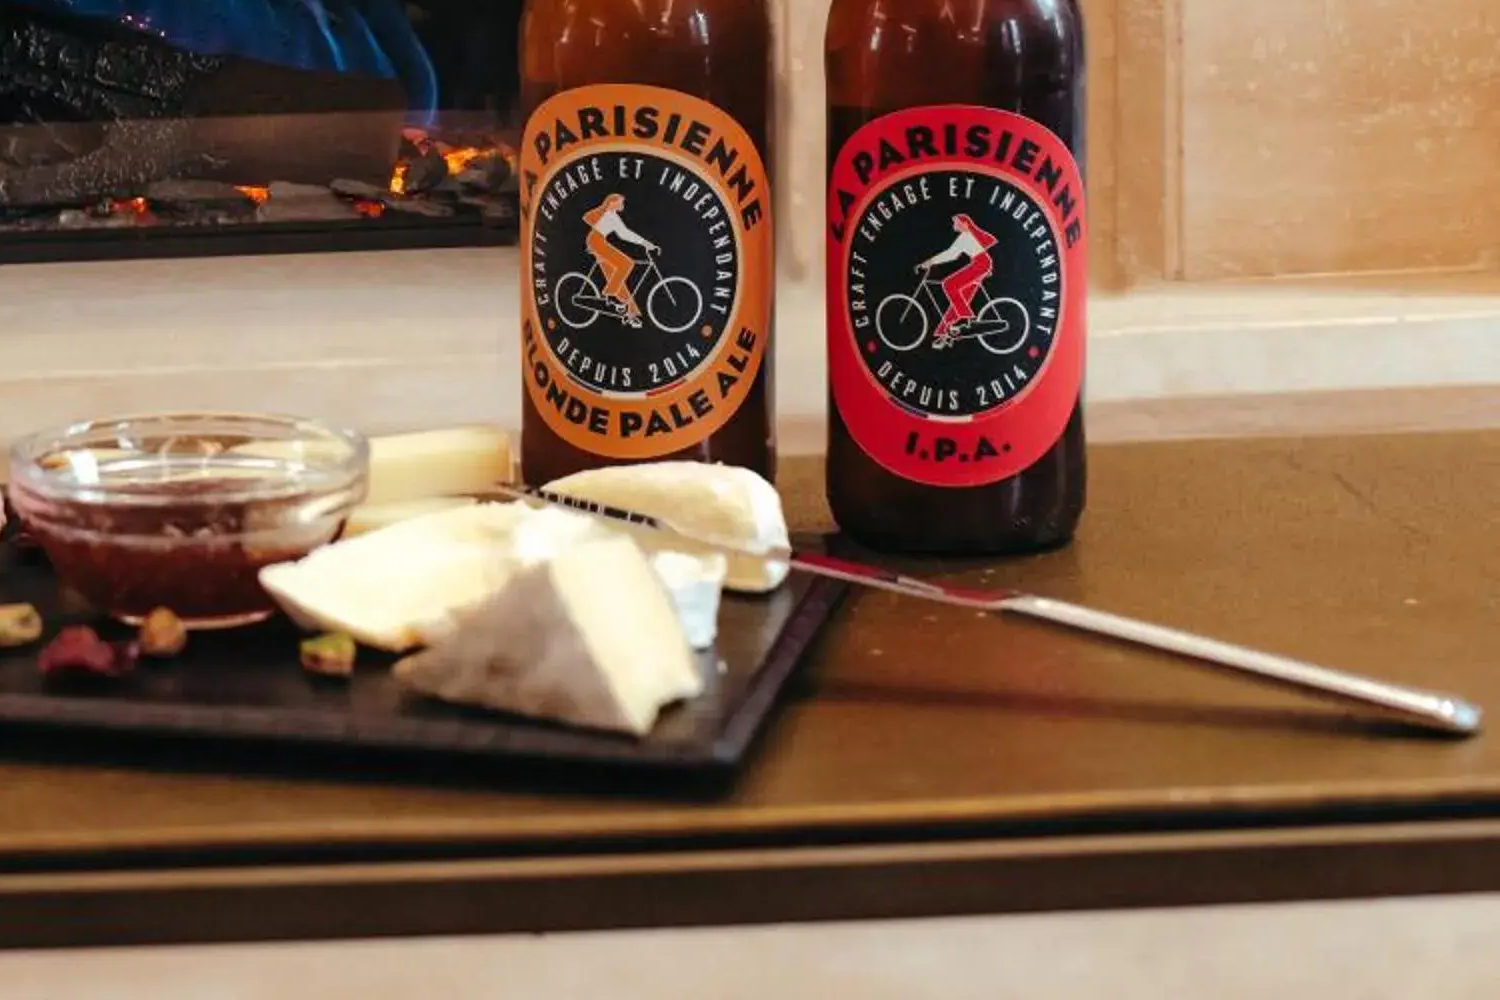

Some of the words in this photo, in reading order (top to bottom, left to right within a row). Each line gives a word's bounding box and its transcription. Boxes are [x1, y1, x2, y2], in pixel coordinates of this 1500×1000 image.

[534, 104, 763, 231] PARISIENNE
[619, 157, 645, 180] ET
[831, 188, 856, 244] LA
[851, 122, 1082, 249] PARISIENNE
[851, 251, 870, 329] CRAFT
[949, 177, 975, 199] ET
[557, 337, 632, 388] DEPUIS
[648, 342, 701, 384] 2014
[619, 388, 714, 438] PALE
[716, 326, 756, 399] ALE
[877, 359, 959, 411] DEPUIS
[975, 364, 1028, 407] 2014
[905, 430, 1012, 463] I.P.A.
